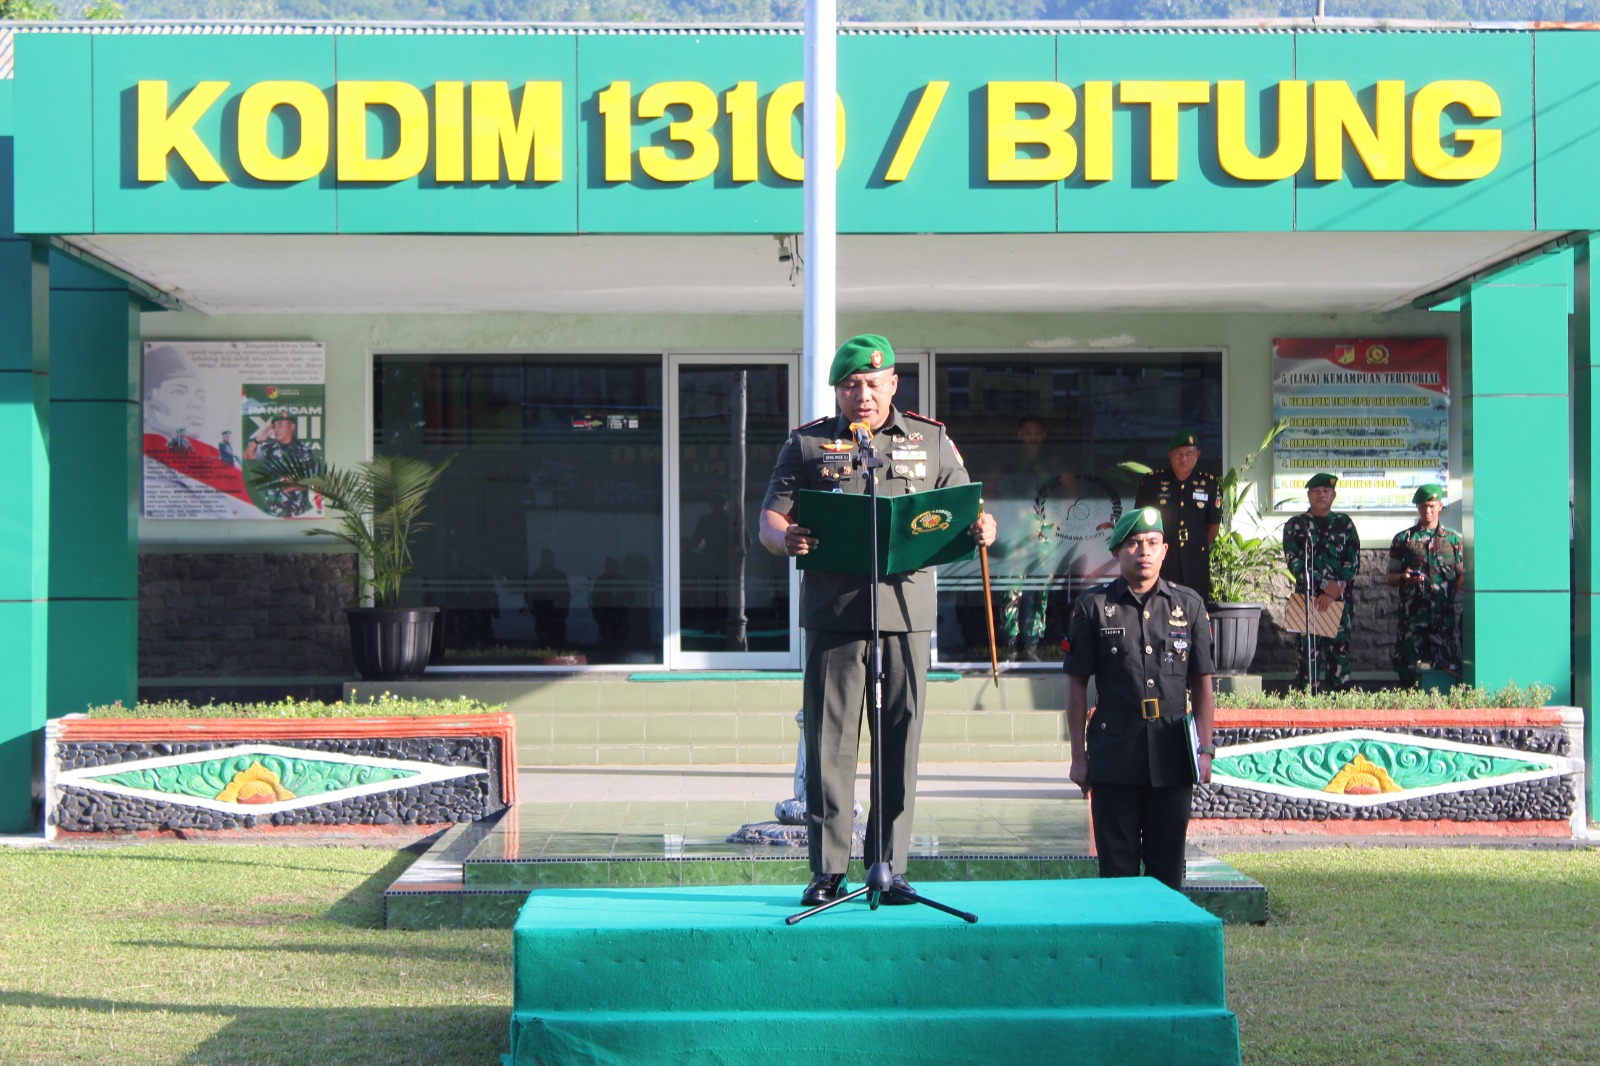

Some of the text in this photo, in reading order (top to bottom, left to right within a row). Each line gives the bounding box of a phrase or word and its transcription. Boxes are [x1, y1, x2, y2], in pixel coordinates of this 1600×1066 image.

[137, 79, 1503, 183] KODIM 1310 / BITUNG
[1281, 372, 1440, 386] 5 (LIMA) KEMAMPUAN TERITORIAL
[1289, 396, 1330, 407] KEMAMPUAN
[1289, 417, 1331, 427] KEMAMPUAN
[1289, 438, 1331, 448] KEMAMPUAN
[1289, 459, 1331, 468] KEMAMPUAN
